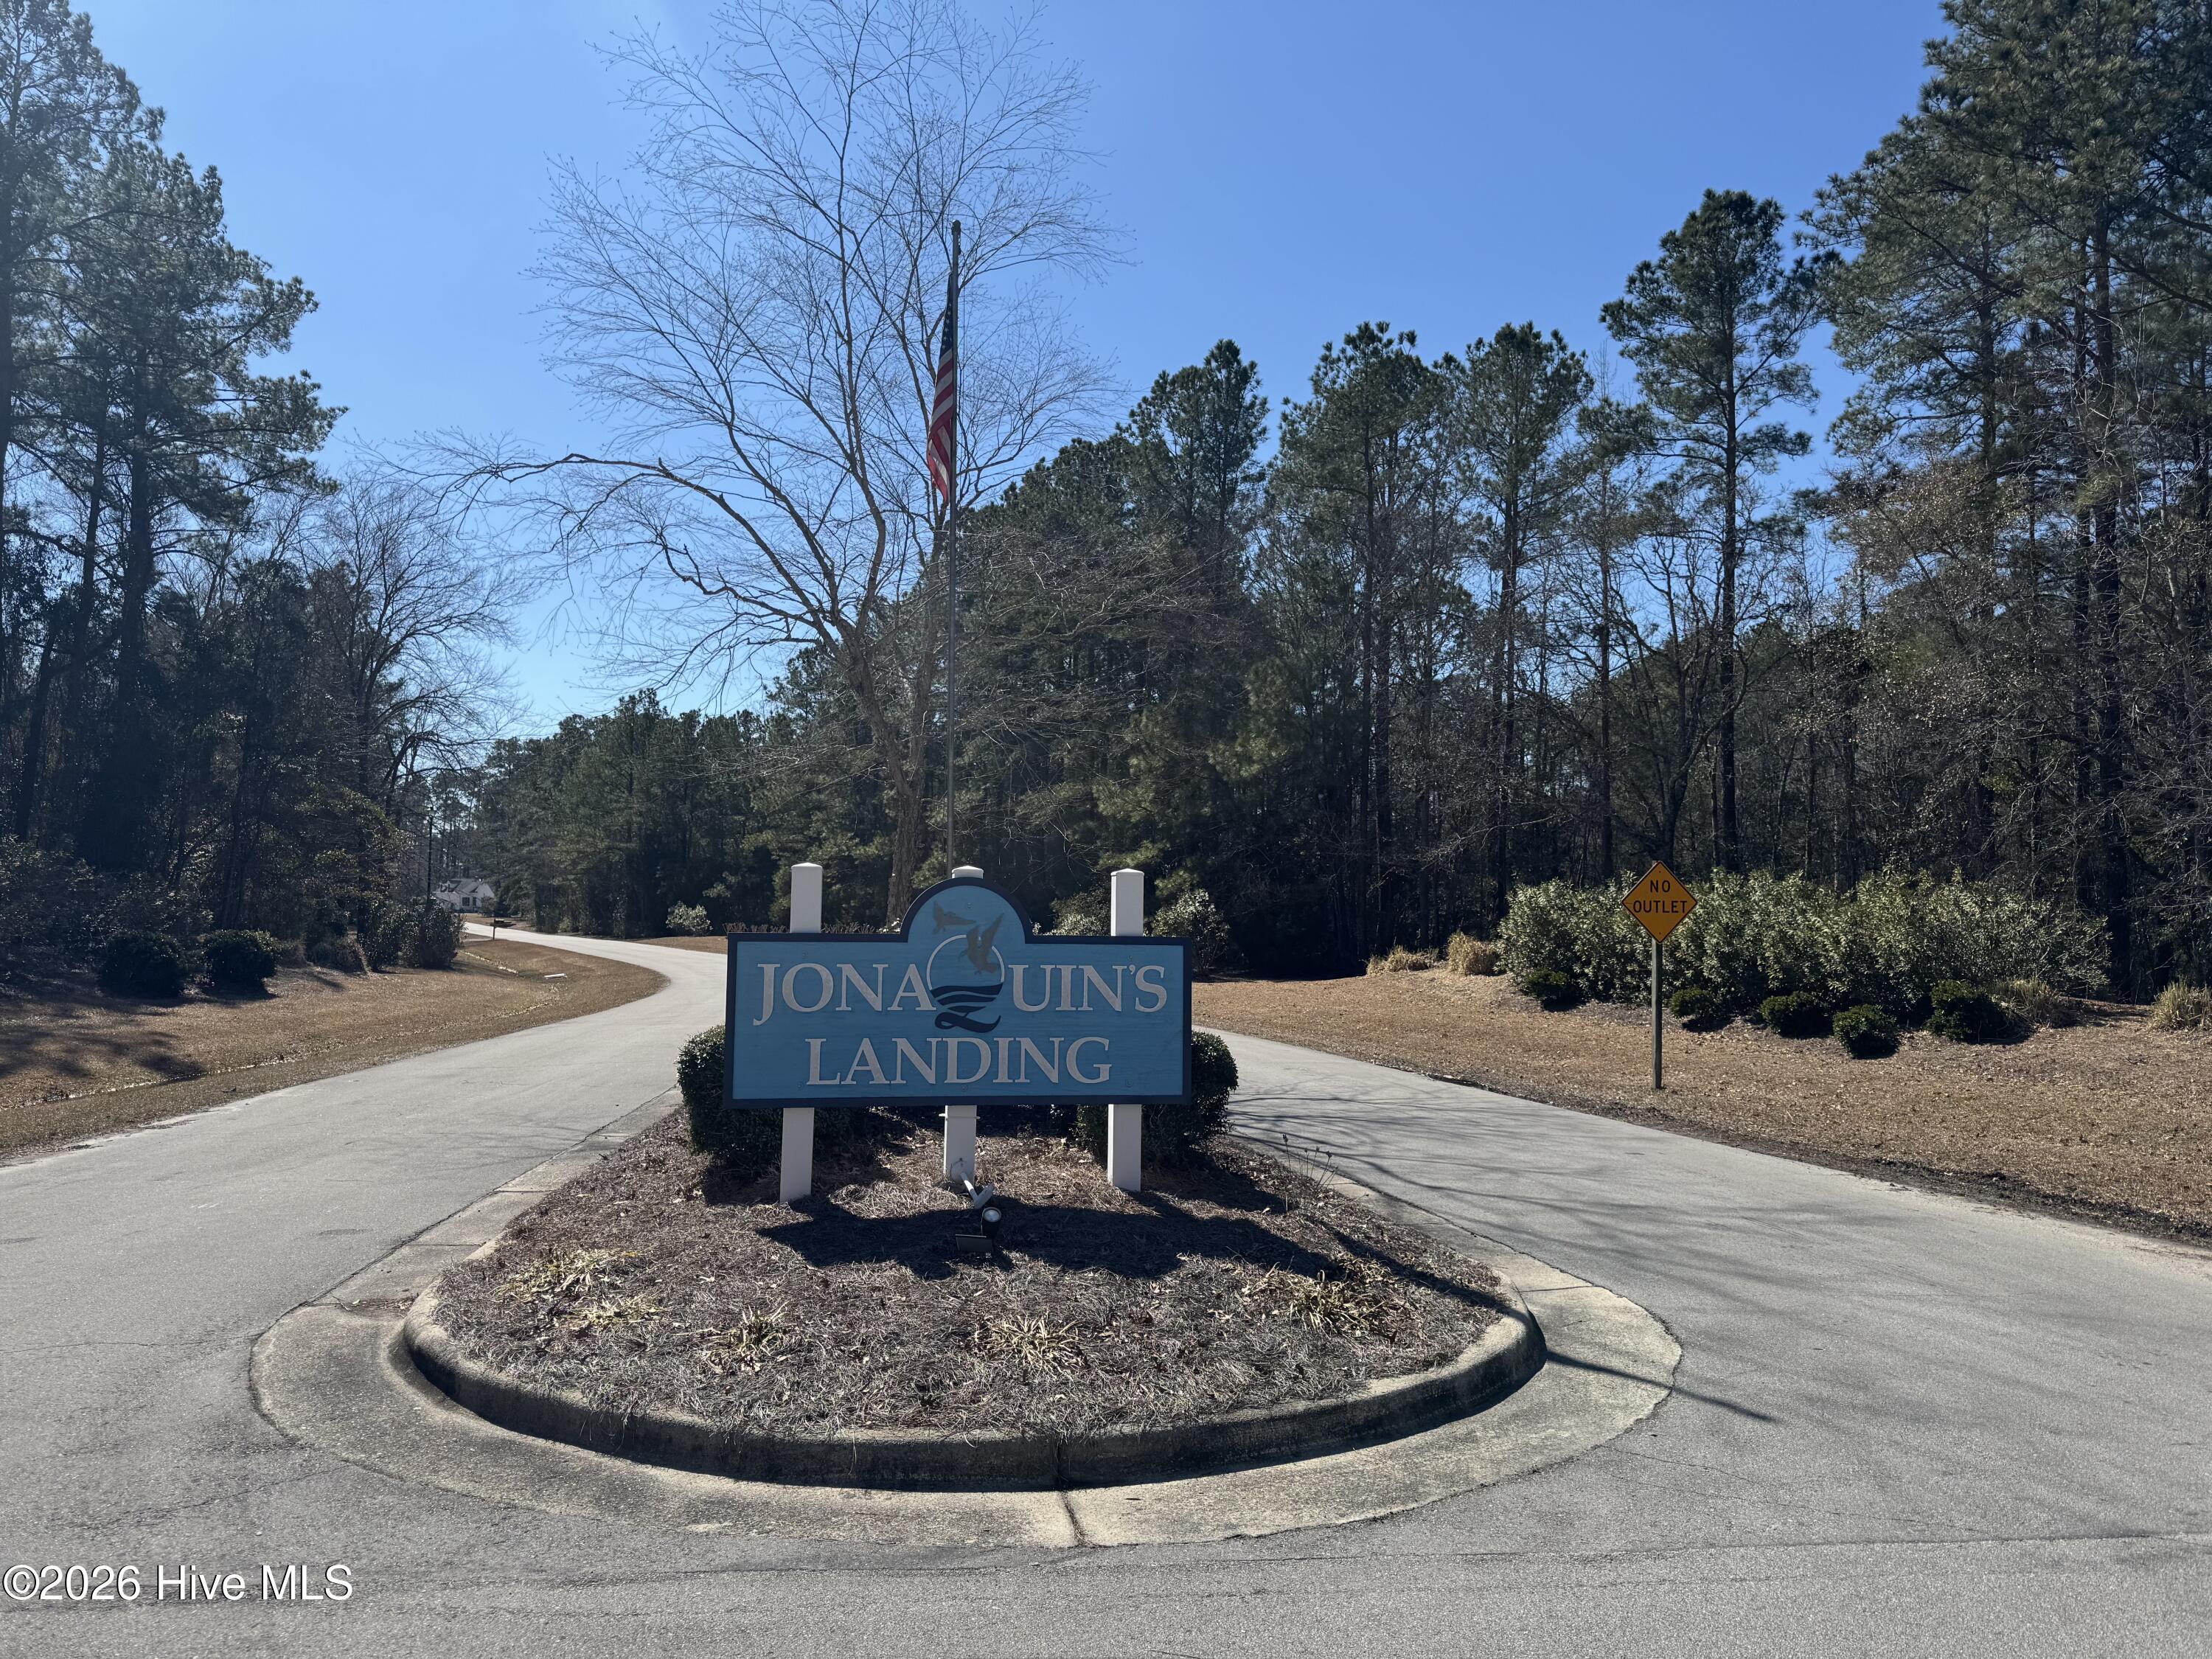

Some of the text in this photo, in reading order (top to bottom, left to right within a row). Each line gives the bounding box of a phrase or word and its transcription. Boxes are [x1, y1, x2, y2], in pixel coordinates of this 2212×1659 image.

[1649, 880, 1671, 893] NO
[1632, 900, 1687, 914] OUTLET
[804, 1037, 1112, 1085] LANDING
